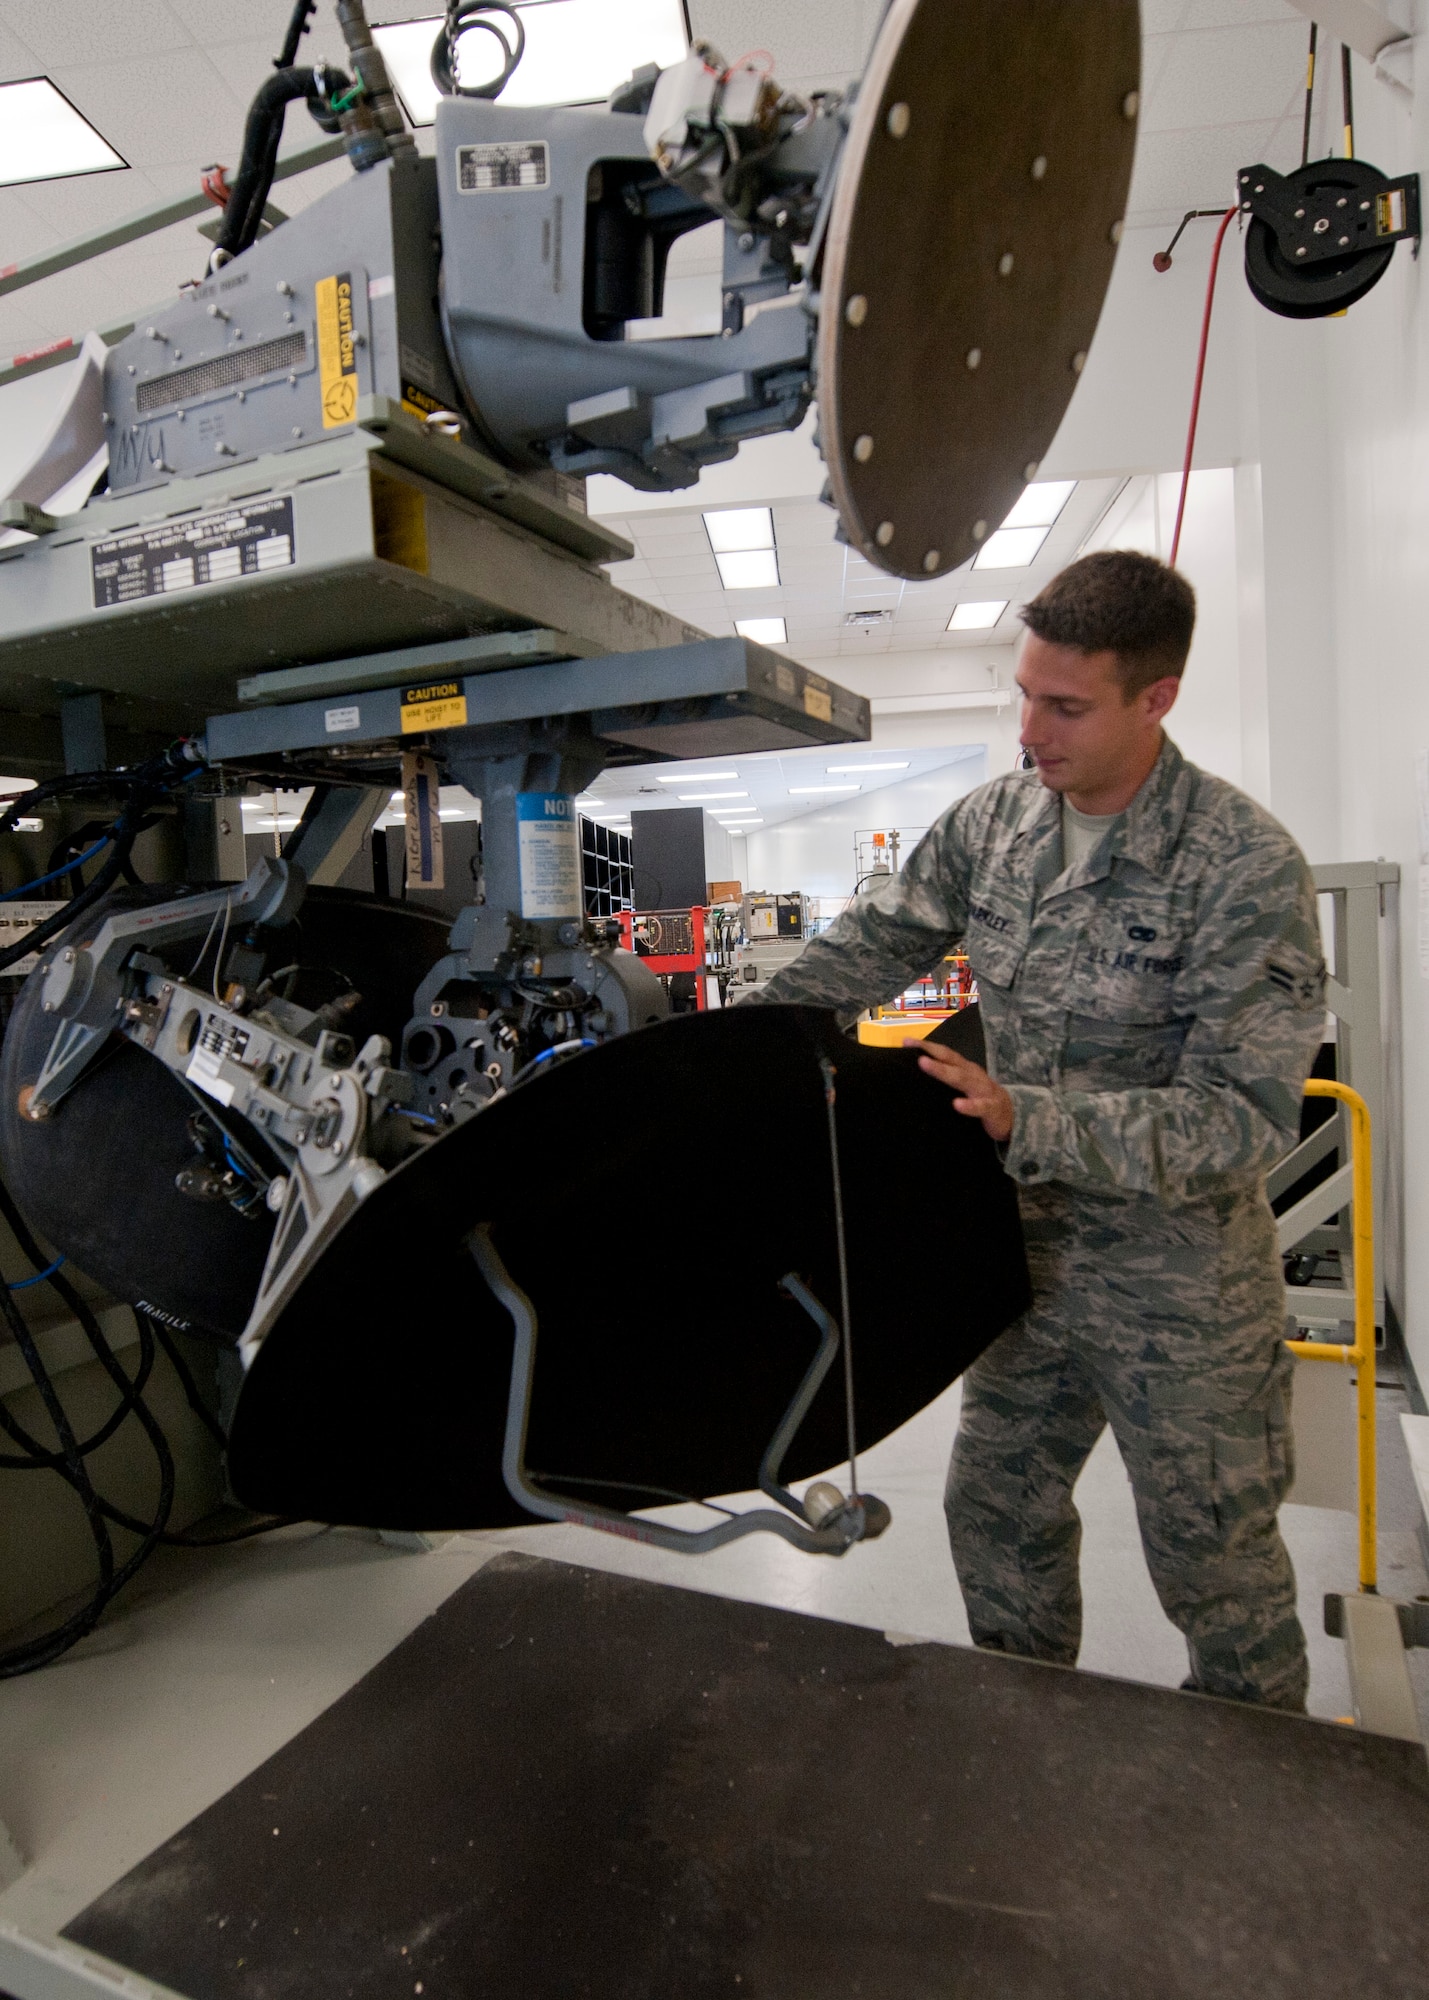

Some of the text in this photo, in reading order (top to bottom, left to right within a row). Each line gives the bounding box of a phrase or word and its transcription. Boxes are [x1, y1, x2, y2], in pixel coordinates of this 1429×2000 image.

[337, 282, 354, 368] CAUTION
[173, 522, 194, 536] PLATE
[241, 499, 286, 517] INFORMATION
[232, 524, 266, 540] LOCATION
[407, 683, 459, 702] CAUTION
[405, 708, 421, 718] USE
[450, 702, 461, 711] TO
[425, 713, 442, 723] LIFT
[1113, 951, 1138, 972] AIR
[1142, 954, 1184, 975] FORCE
[134, 1300, 191, 1331] FRAGILE
